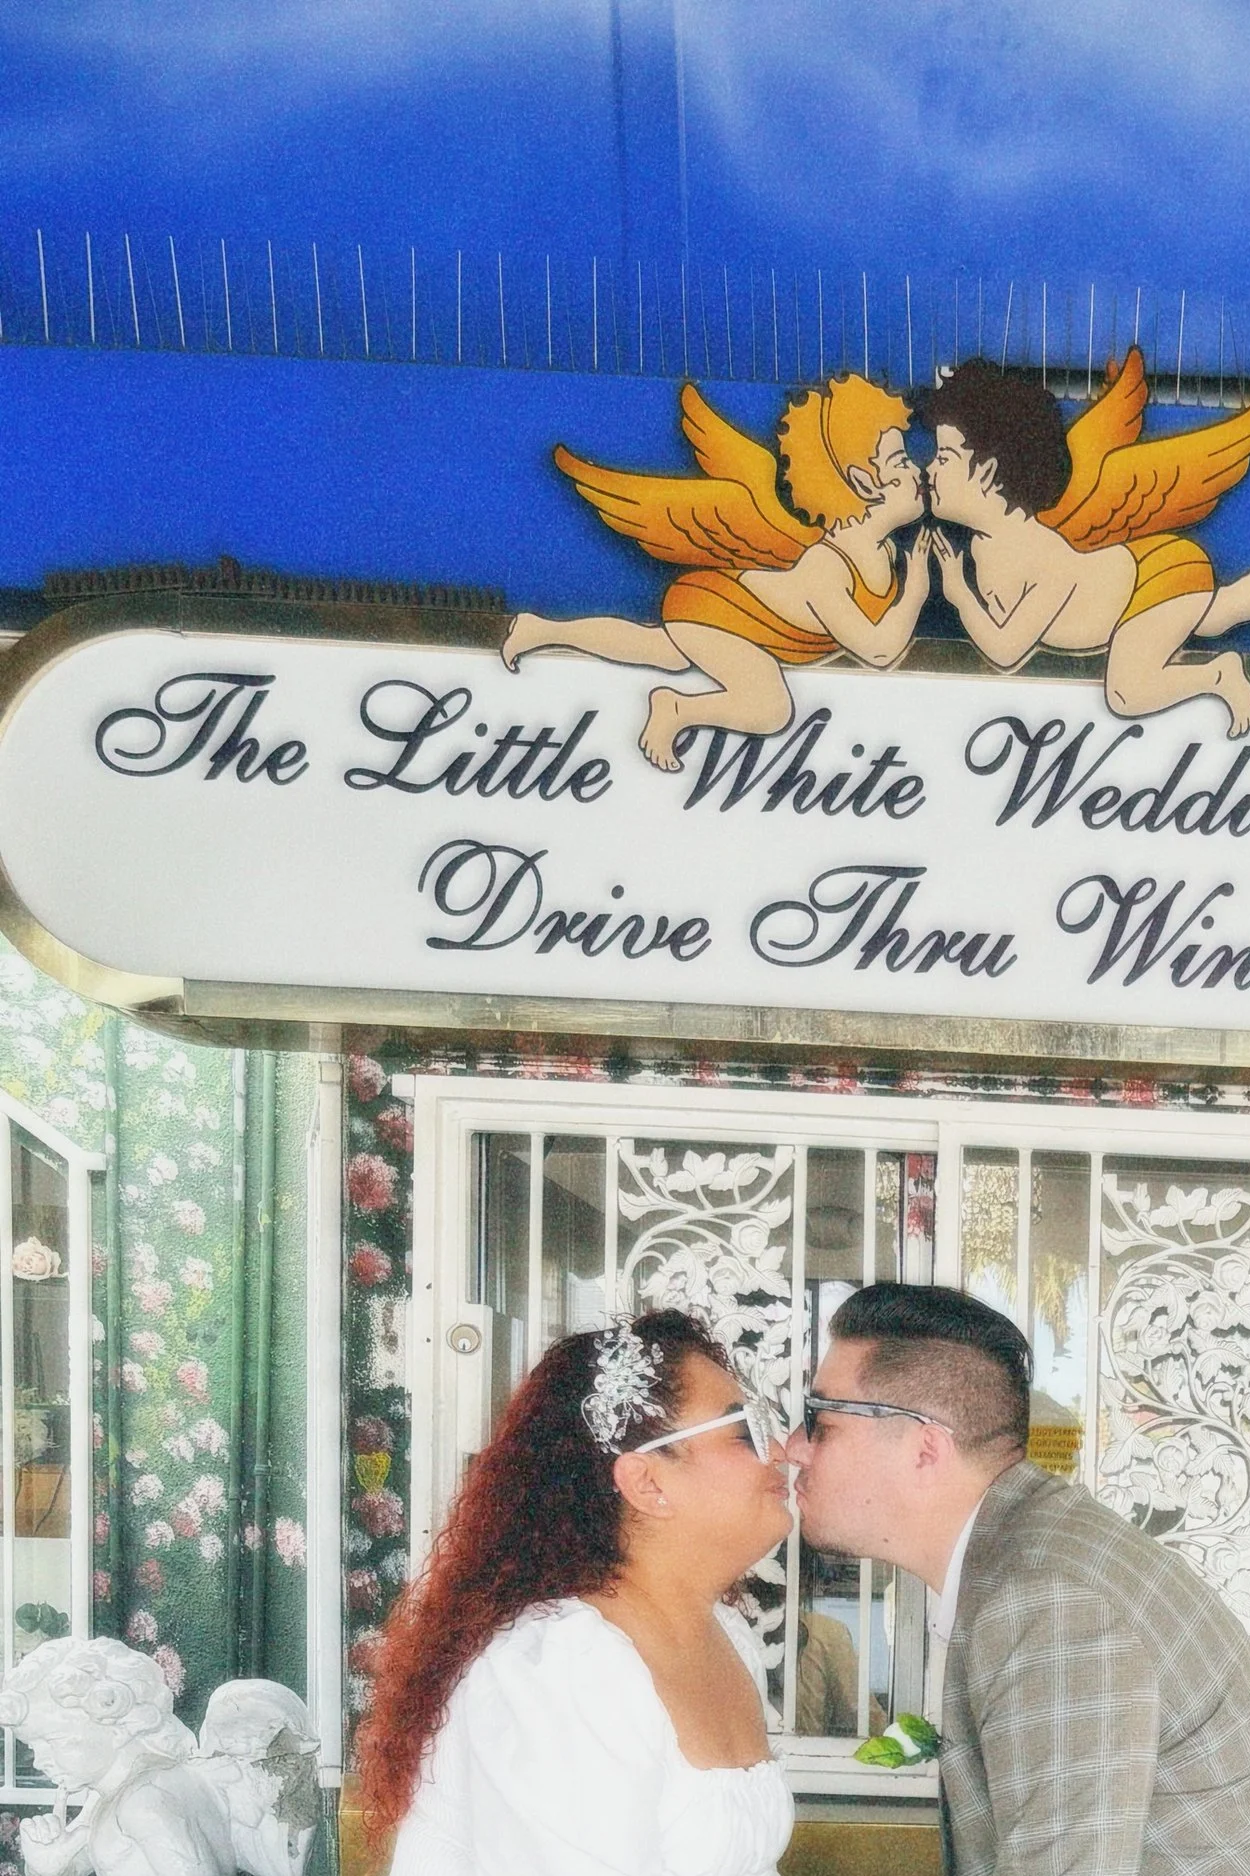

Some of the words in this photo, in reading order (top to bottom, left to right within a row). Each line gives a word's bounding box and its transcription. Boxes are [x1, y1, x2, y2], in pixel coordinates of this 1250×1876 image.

[95, 672, 310, 786] The
[343, 679, 613, 804] Little
[673, 707, 926, 820] White
[417, 838, 712, 962] Drive
[749, 864, 1018, 978] Thru
